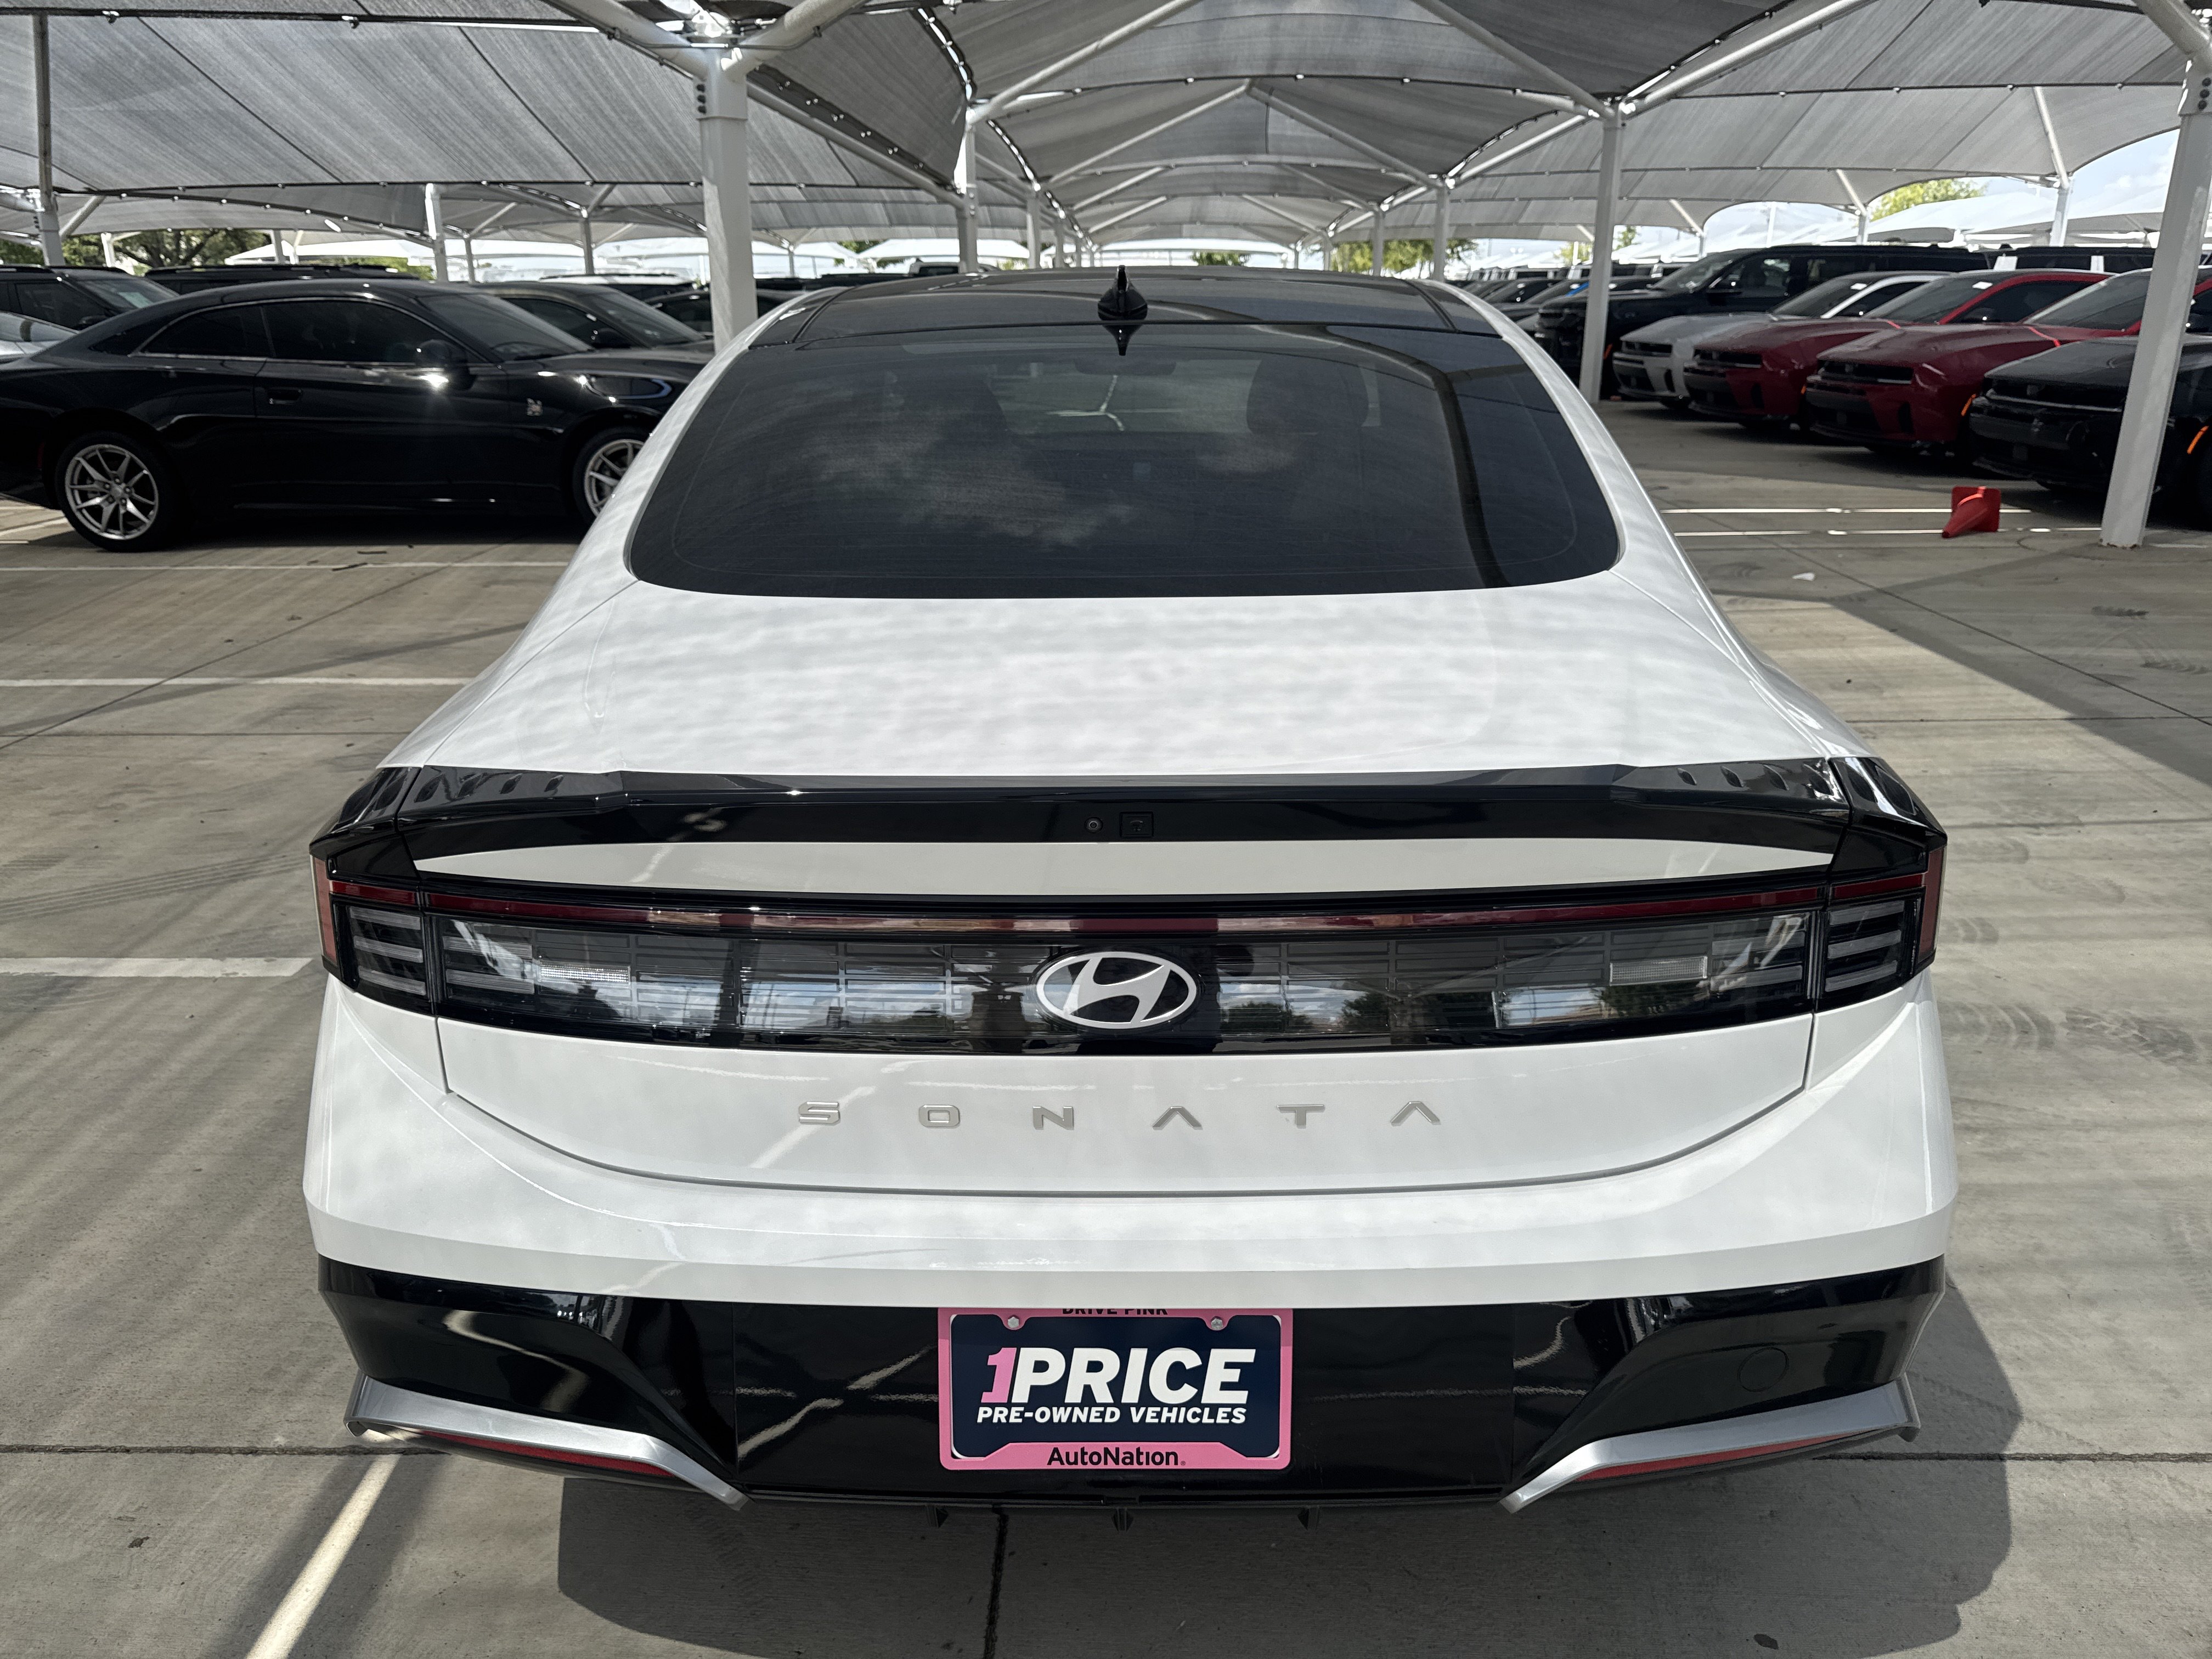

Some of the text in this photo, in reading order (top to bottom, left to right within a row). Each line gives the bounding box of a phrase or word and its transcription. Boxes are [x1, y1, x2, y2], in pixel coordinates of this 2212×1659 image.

[798, 1101, 1442, 1130] SONATA
[980, 1347, 1256, 1404] 1PRICE
[977, 1406, 1247, 1424] PRE-OWNED VEHICLES
